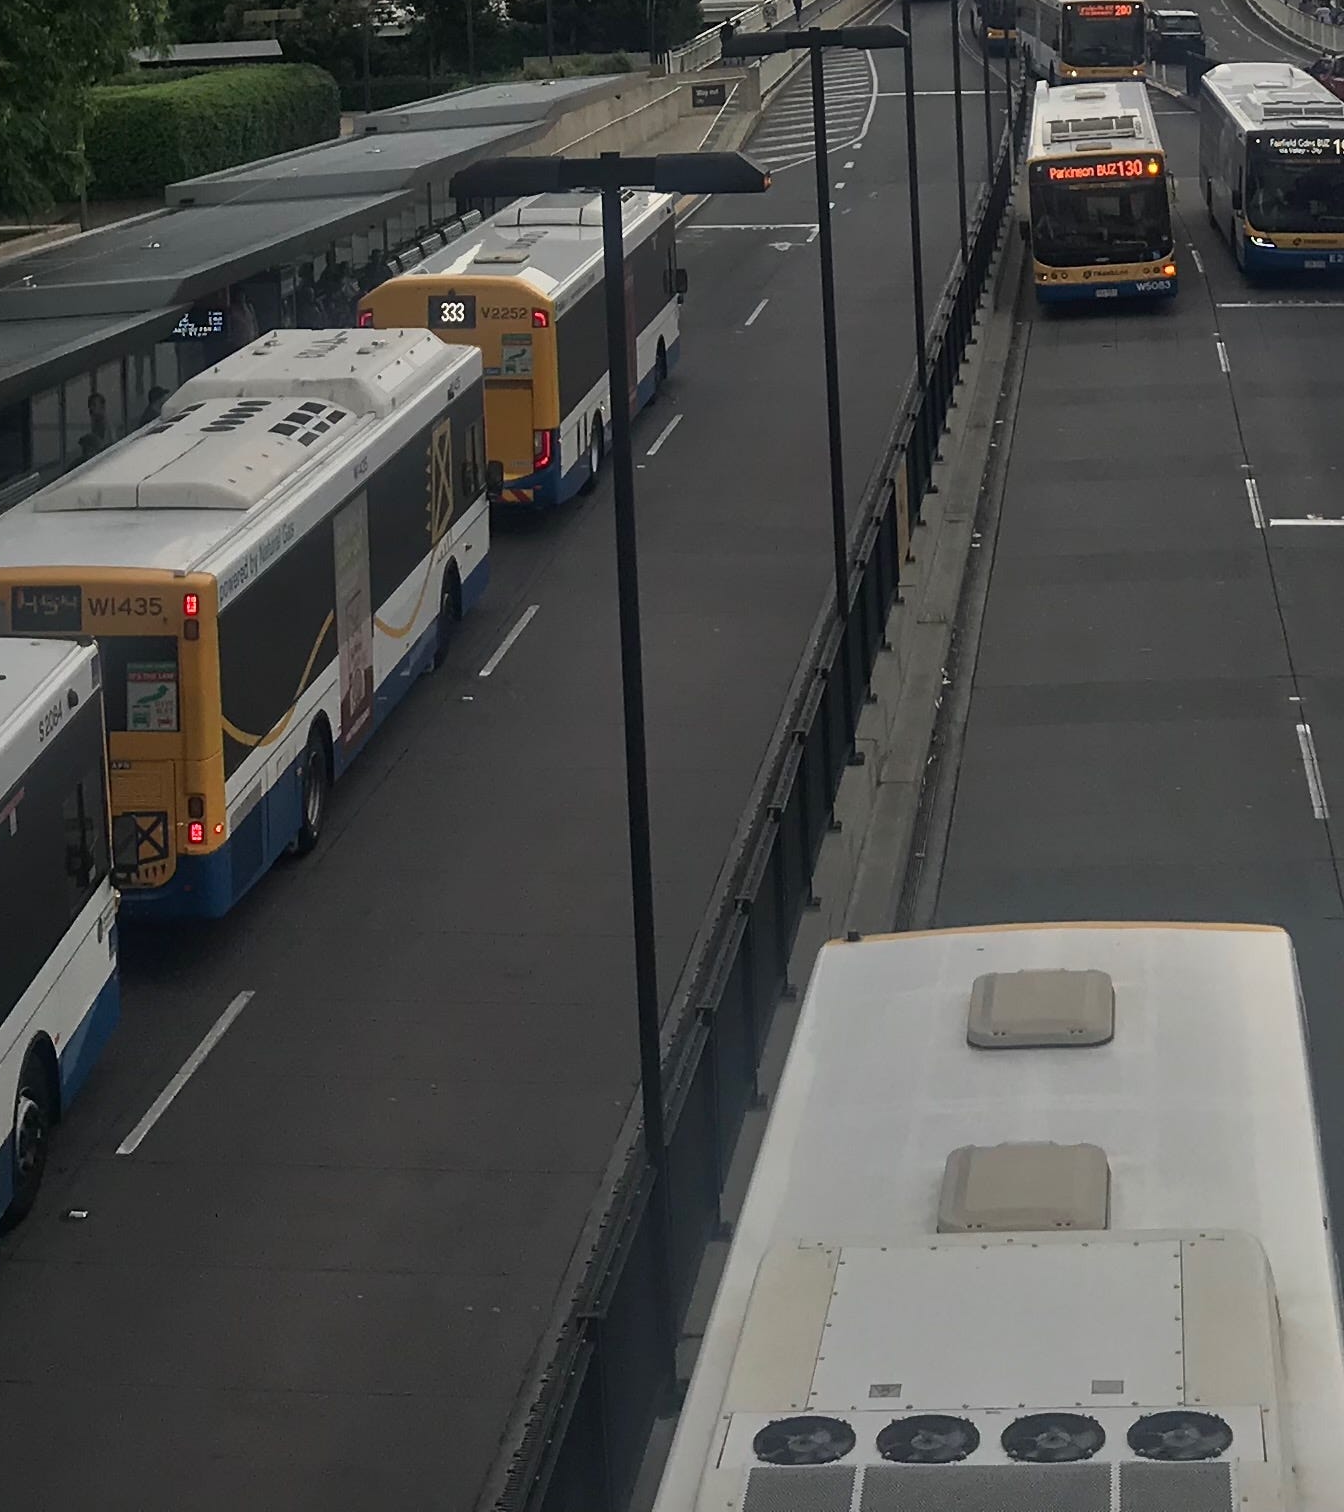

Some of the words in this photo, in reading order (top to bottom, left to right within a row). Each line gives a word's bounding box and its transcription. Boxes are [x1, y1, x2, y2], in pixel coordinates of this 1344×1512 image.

[1269, 138, 1297, 148] Fairfield
[1049, 166, 1095, 180] Parkinson
[1096, 164, 1117, 177] BUZ
[1117, 159, 1144, 177] 130
[440, 302, 465, 322] 333
[481, 307, 528, 320] V2252
